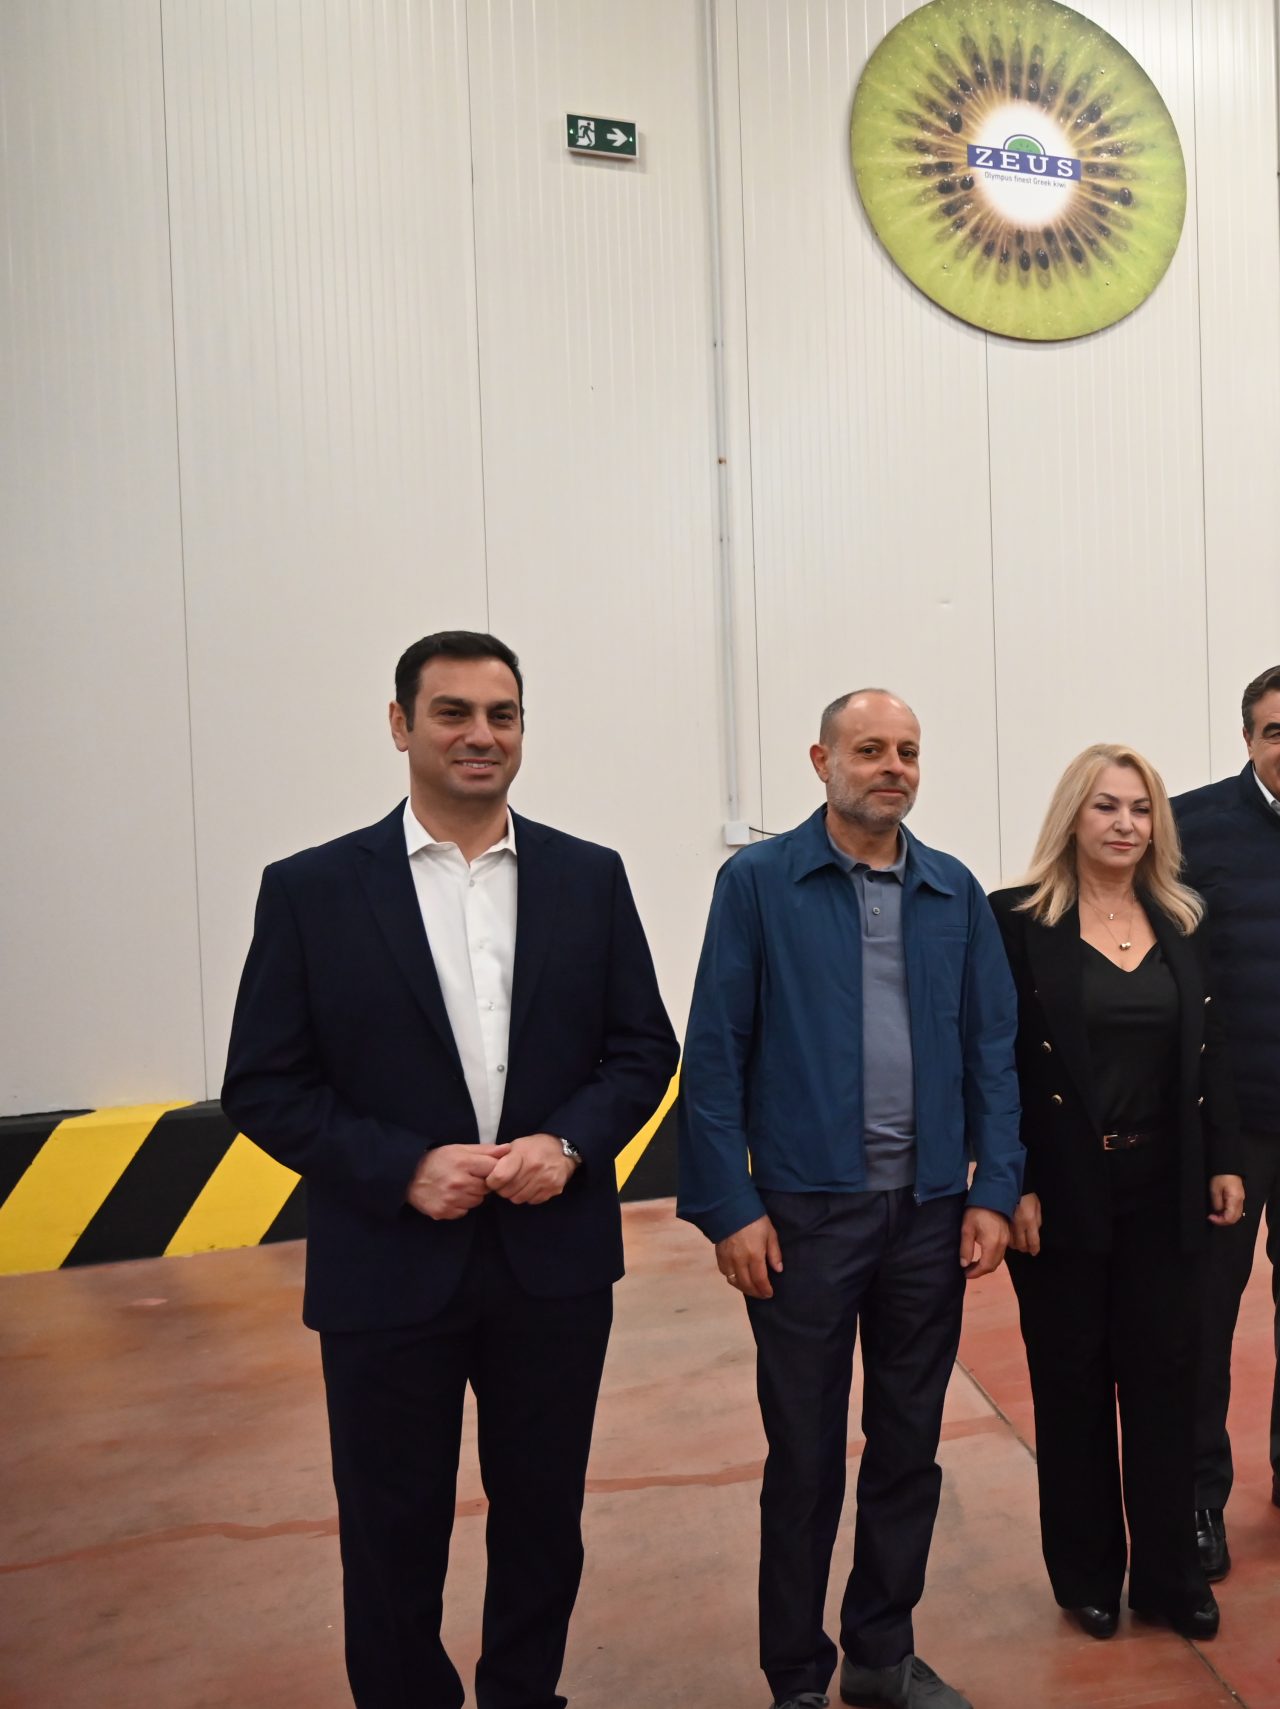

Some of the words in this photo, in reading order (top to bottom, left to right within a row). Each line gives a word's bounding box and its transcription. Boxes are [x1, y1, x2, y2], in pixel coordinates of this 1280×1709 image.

[975, 147, 1074, 178] ZEUS
[984, 171, 1013, 182] Olympus
[1014, 175, 1032, 184] finest
[1033, 177, 1052, 187] Greek
[1053, 180, 1067, 189] kiwi
